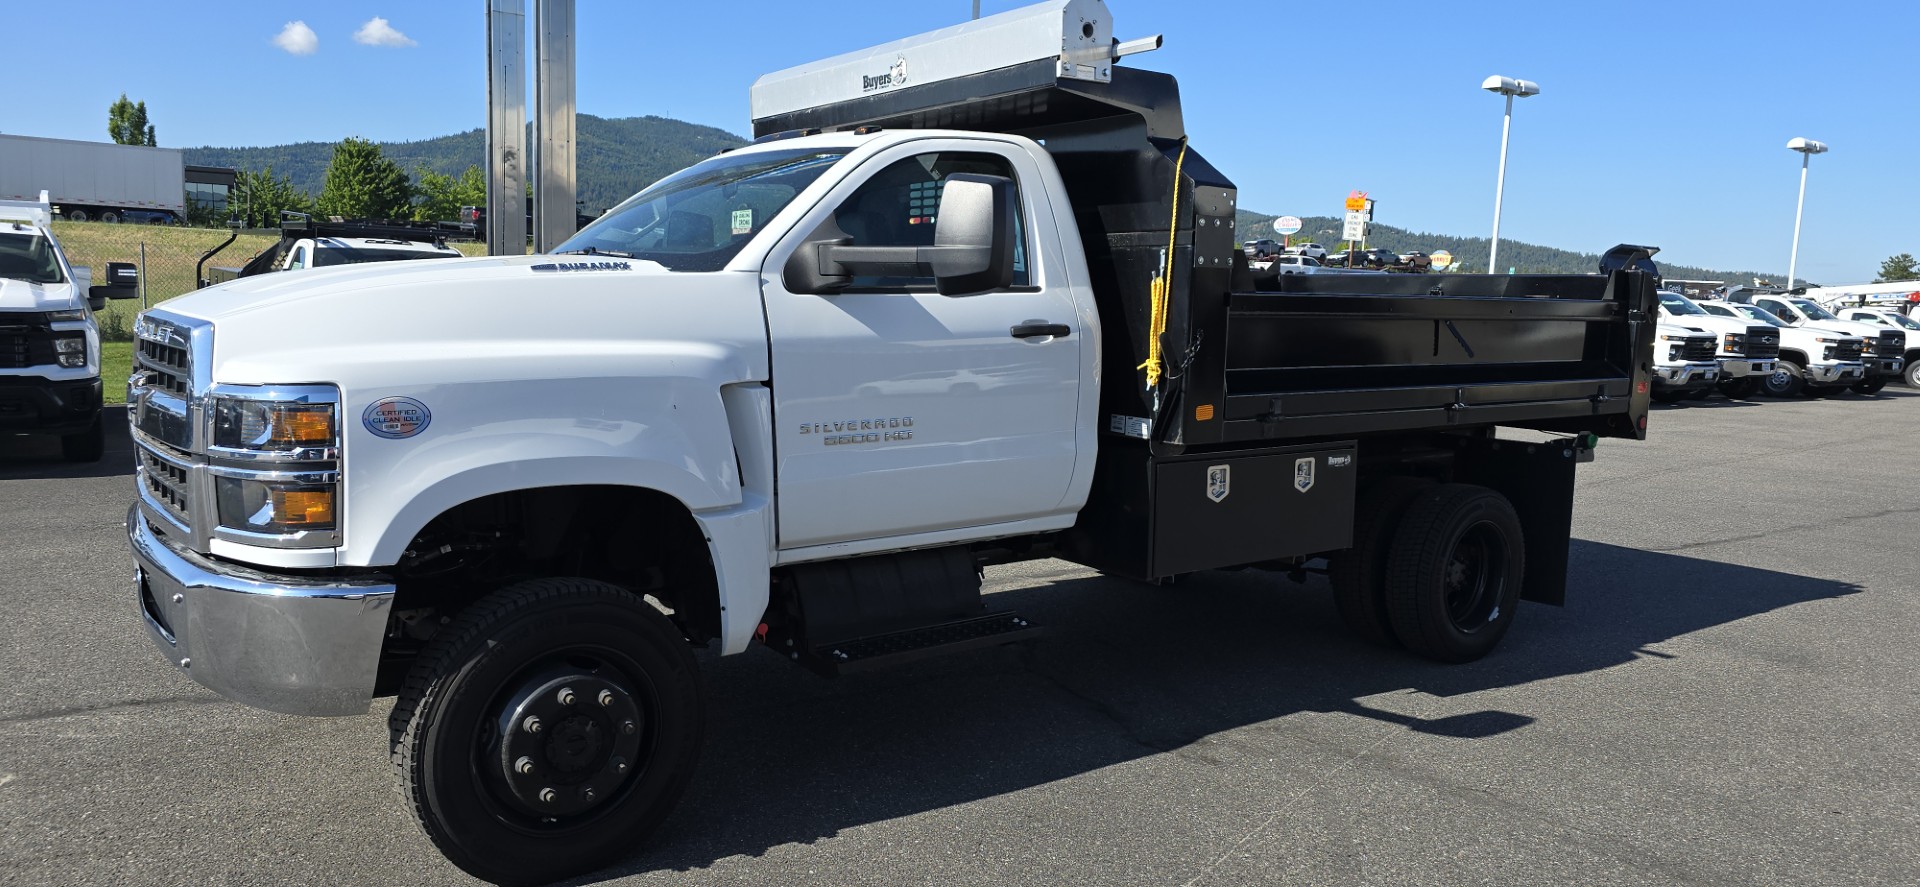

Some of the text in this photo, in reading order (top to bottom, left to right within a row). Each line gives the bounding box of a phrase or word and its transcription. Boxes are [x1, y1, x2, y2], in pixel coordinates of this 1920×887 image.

[863, 73, 892, 90] Buyers
[799, 416, 914, 435] SILVERADO
[884, 429, 913, 442] HD
